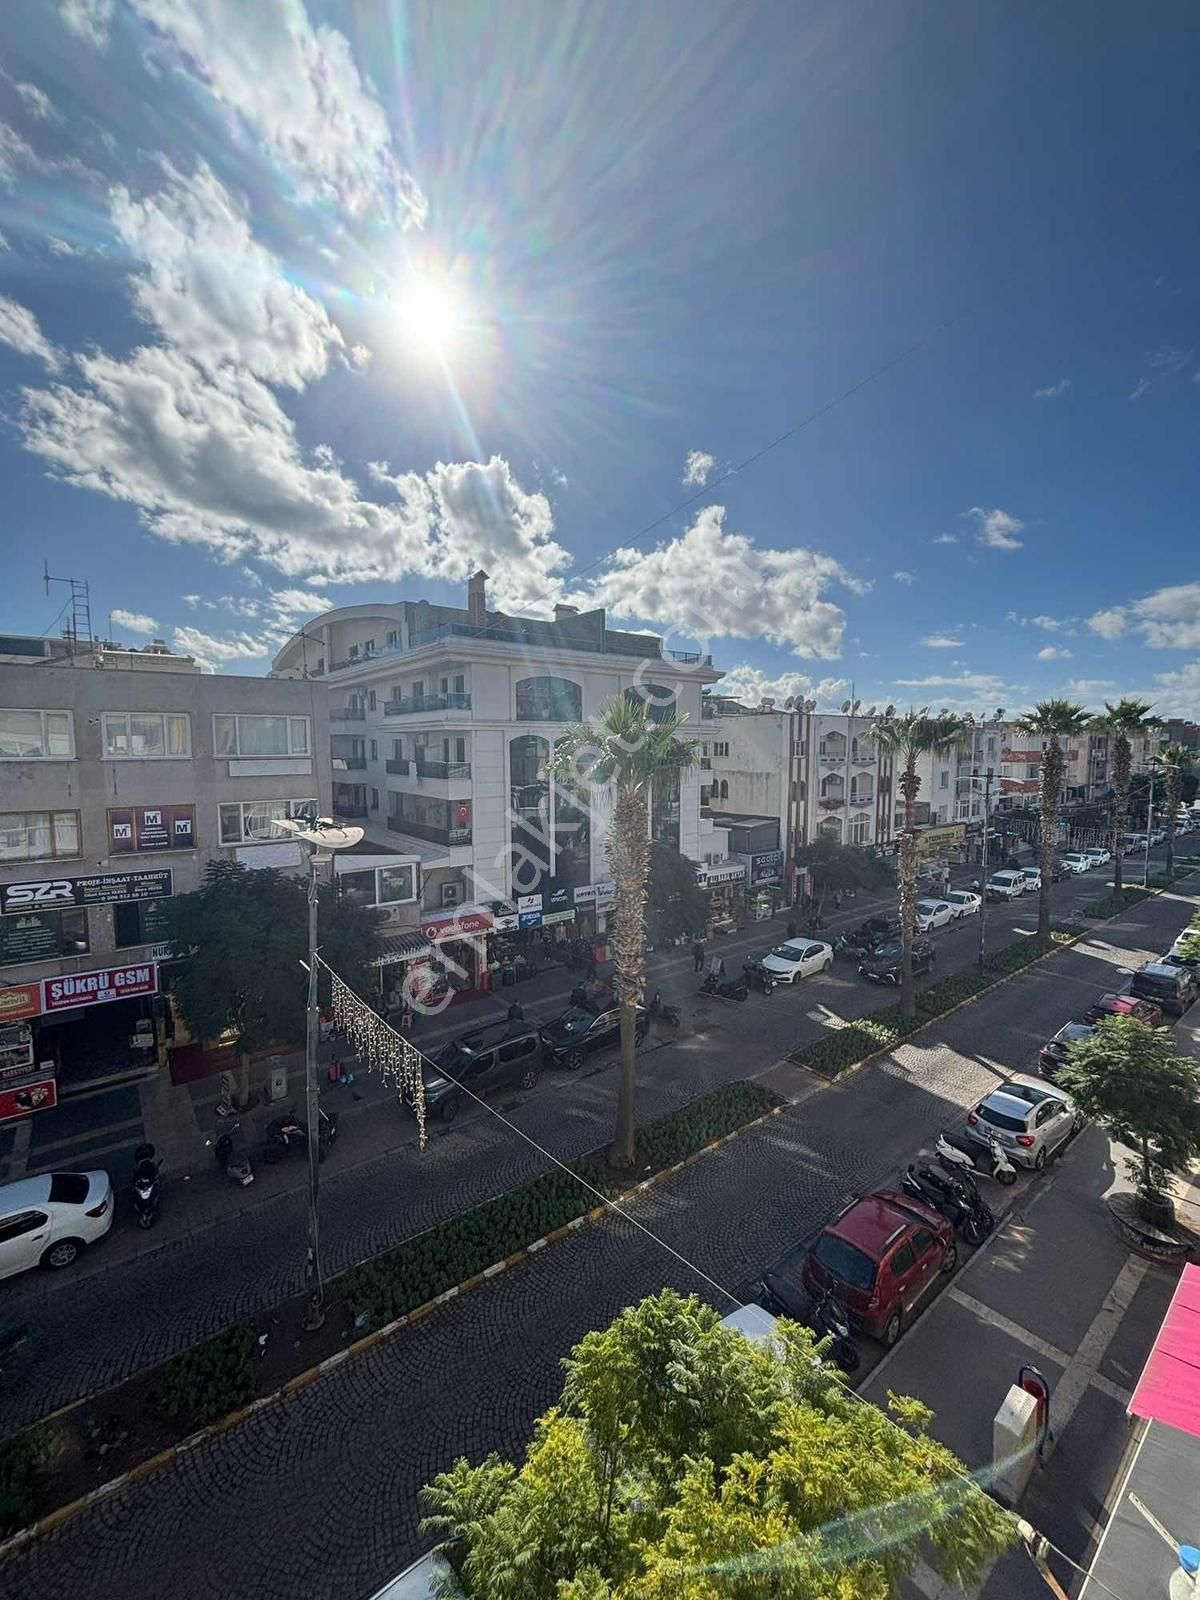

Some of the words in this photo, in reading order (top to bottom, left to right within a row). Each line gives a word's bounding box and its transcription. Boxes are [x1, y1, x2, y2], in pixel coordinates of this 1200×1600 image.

[6, 880, 75, 904] SZR
[440, 920, 480, 934] vodafone
[51, 974, 110, 1000] ŞÜKRÜ
[114, 968, 150, 987] GSM
